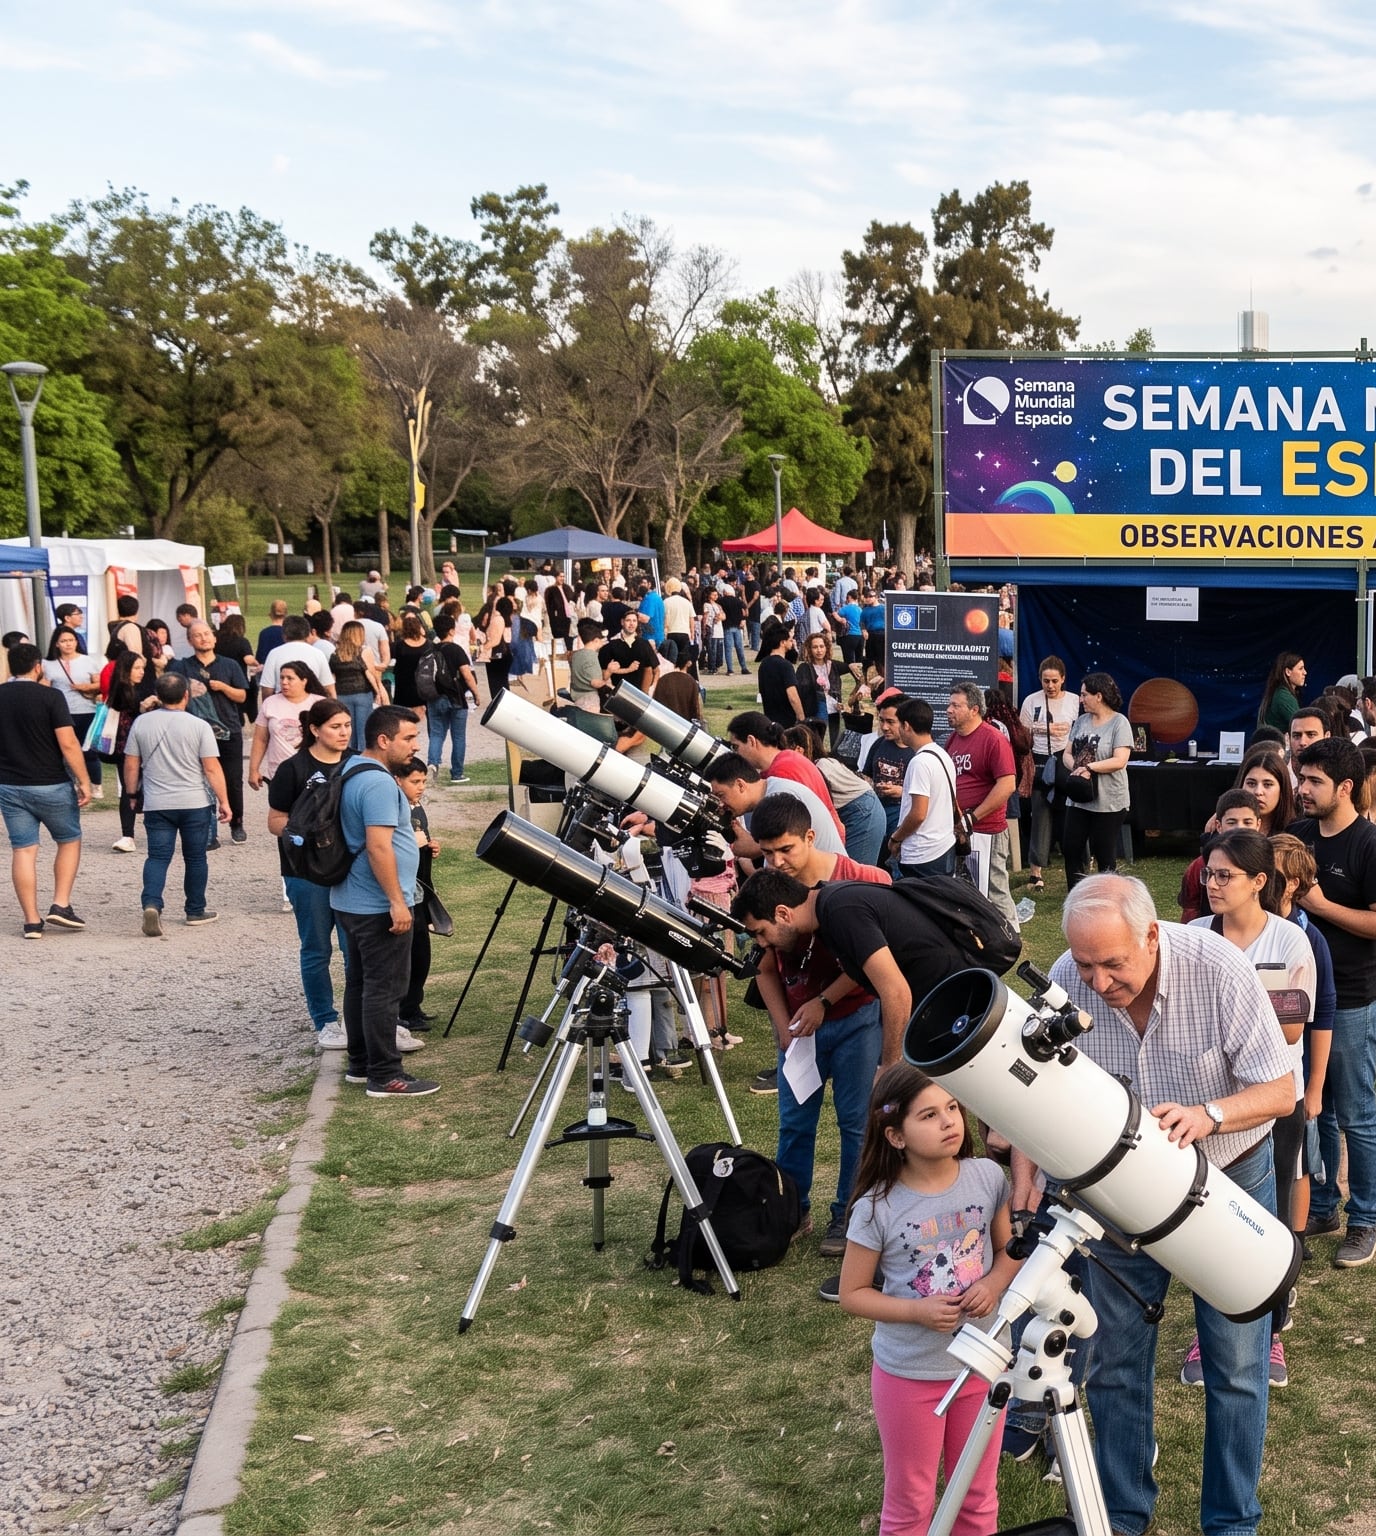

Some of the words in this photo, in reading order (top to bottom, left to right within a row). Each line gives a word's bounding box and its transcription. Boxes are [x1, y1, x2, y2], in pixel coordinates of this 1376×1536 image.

[1014, 377, 1075, 393] Semana
[1014, 393, 1075, 409] Mundial
[1102, 384, 1347, 432] SEMANA
[1014, 410, 1073, 429] Espacio
[1150, 448, 1262, 496] DEL
[1120, 524, 1364, 549] OBSERVACIONES
